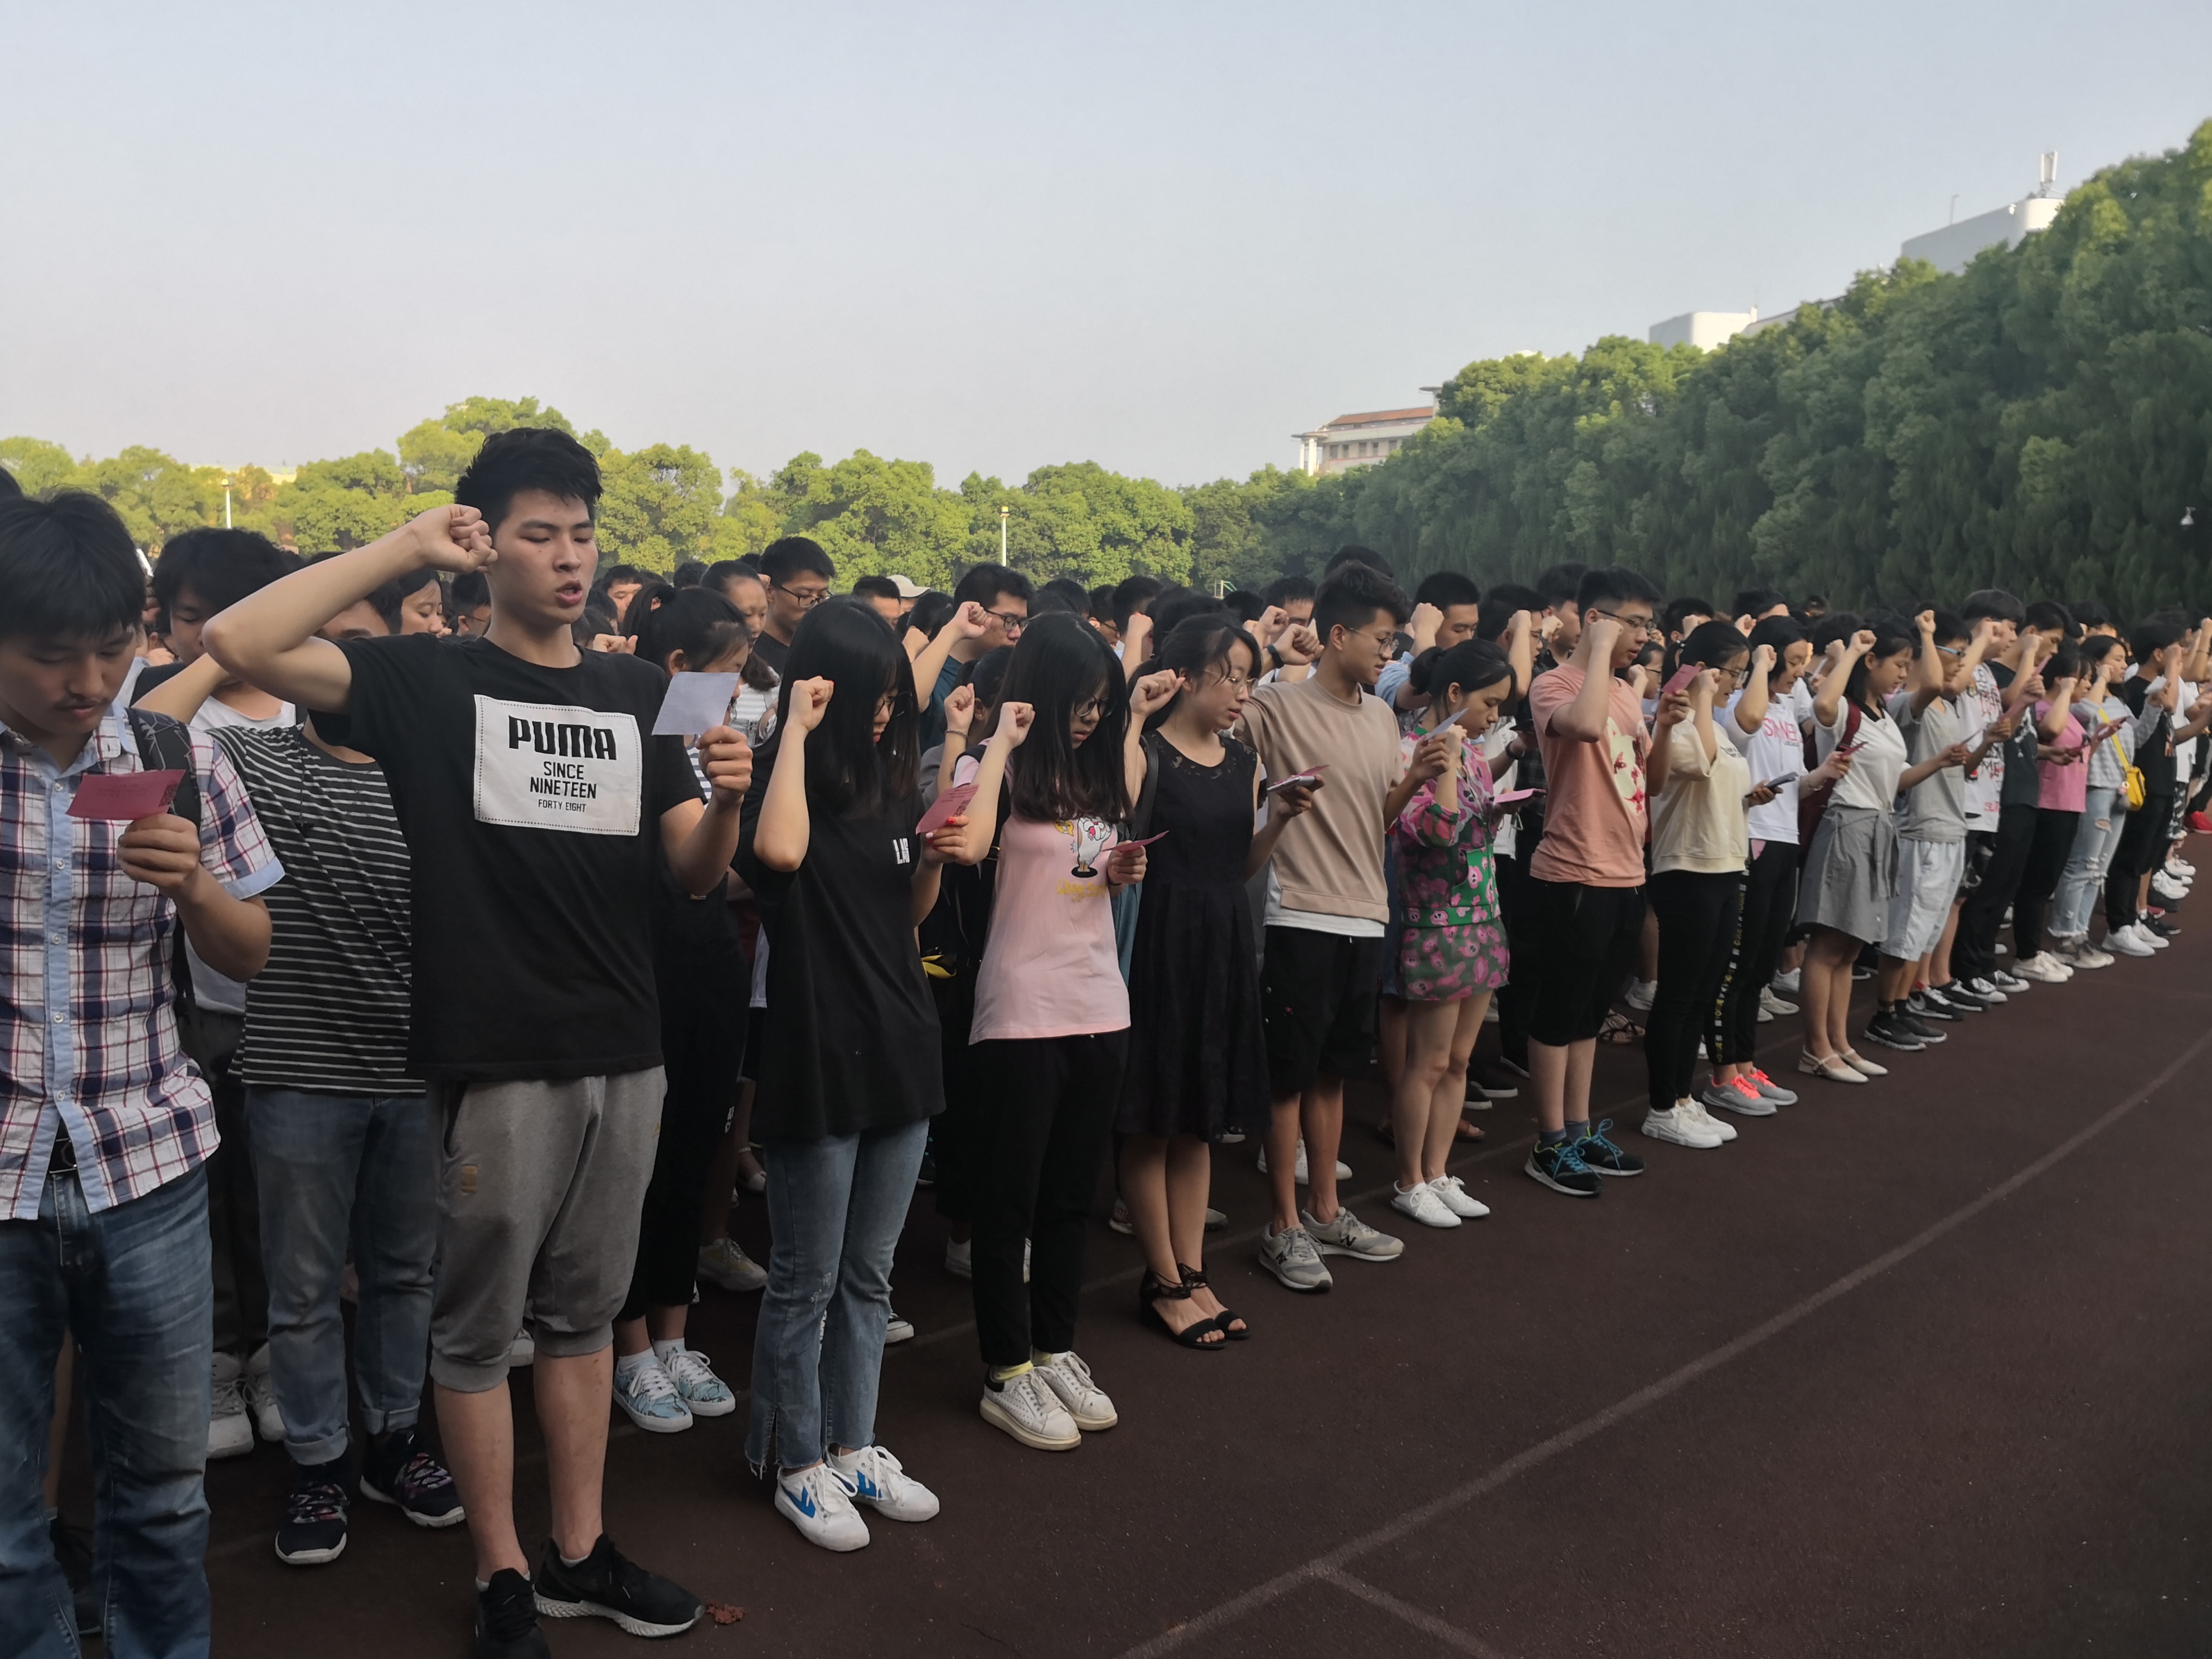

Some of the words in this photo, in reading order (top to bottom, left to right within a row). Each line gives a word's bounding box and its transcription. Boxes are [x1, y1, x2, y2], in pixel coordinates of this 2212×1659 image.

[508, 715, 617, 760] PUMA
[543, 761, 584, 780] SINCE
[530, 777, 596, 799] NINETEEN
[538, 799, 562, 809] FORTY
[565, 802, 586, 812] EIGHT
